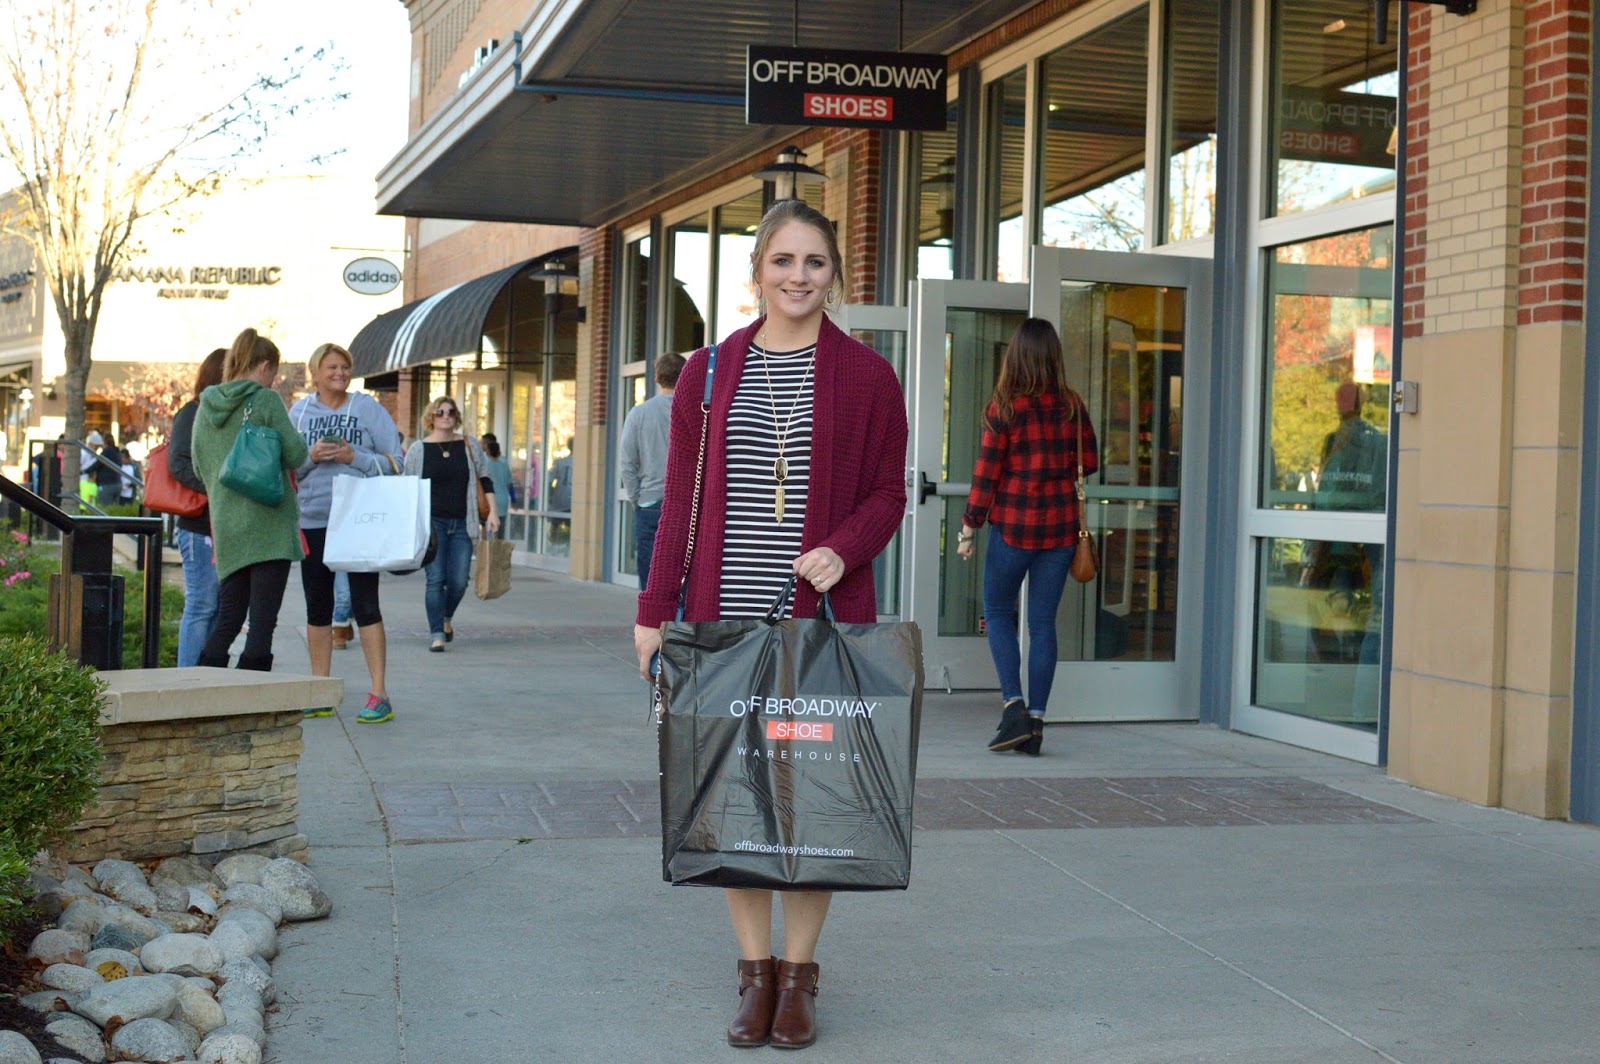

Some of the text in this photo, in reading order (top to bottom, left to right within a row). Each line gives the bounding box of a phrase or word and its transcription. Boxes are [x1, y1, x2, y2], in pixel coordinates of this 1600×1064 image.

[752, 59, 943, 90] OFF BROADWAY
[810, 96, 888, 117] SHOES
[190, 266, 282, 286] REPUBLIC
[347, 270, 398, 284] adidas
[308, 414, 358, 431] UNDER
[354, 511, 388, 525] LOFT
[729, 695, 762, 717] OF
[776, 723, 823, 739] SHOE
[737, 747, 860, 763] WAREHOUSE
[734, 840, 854, 857] offbroadwayshoes.com
